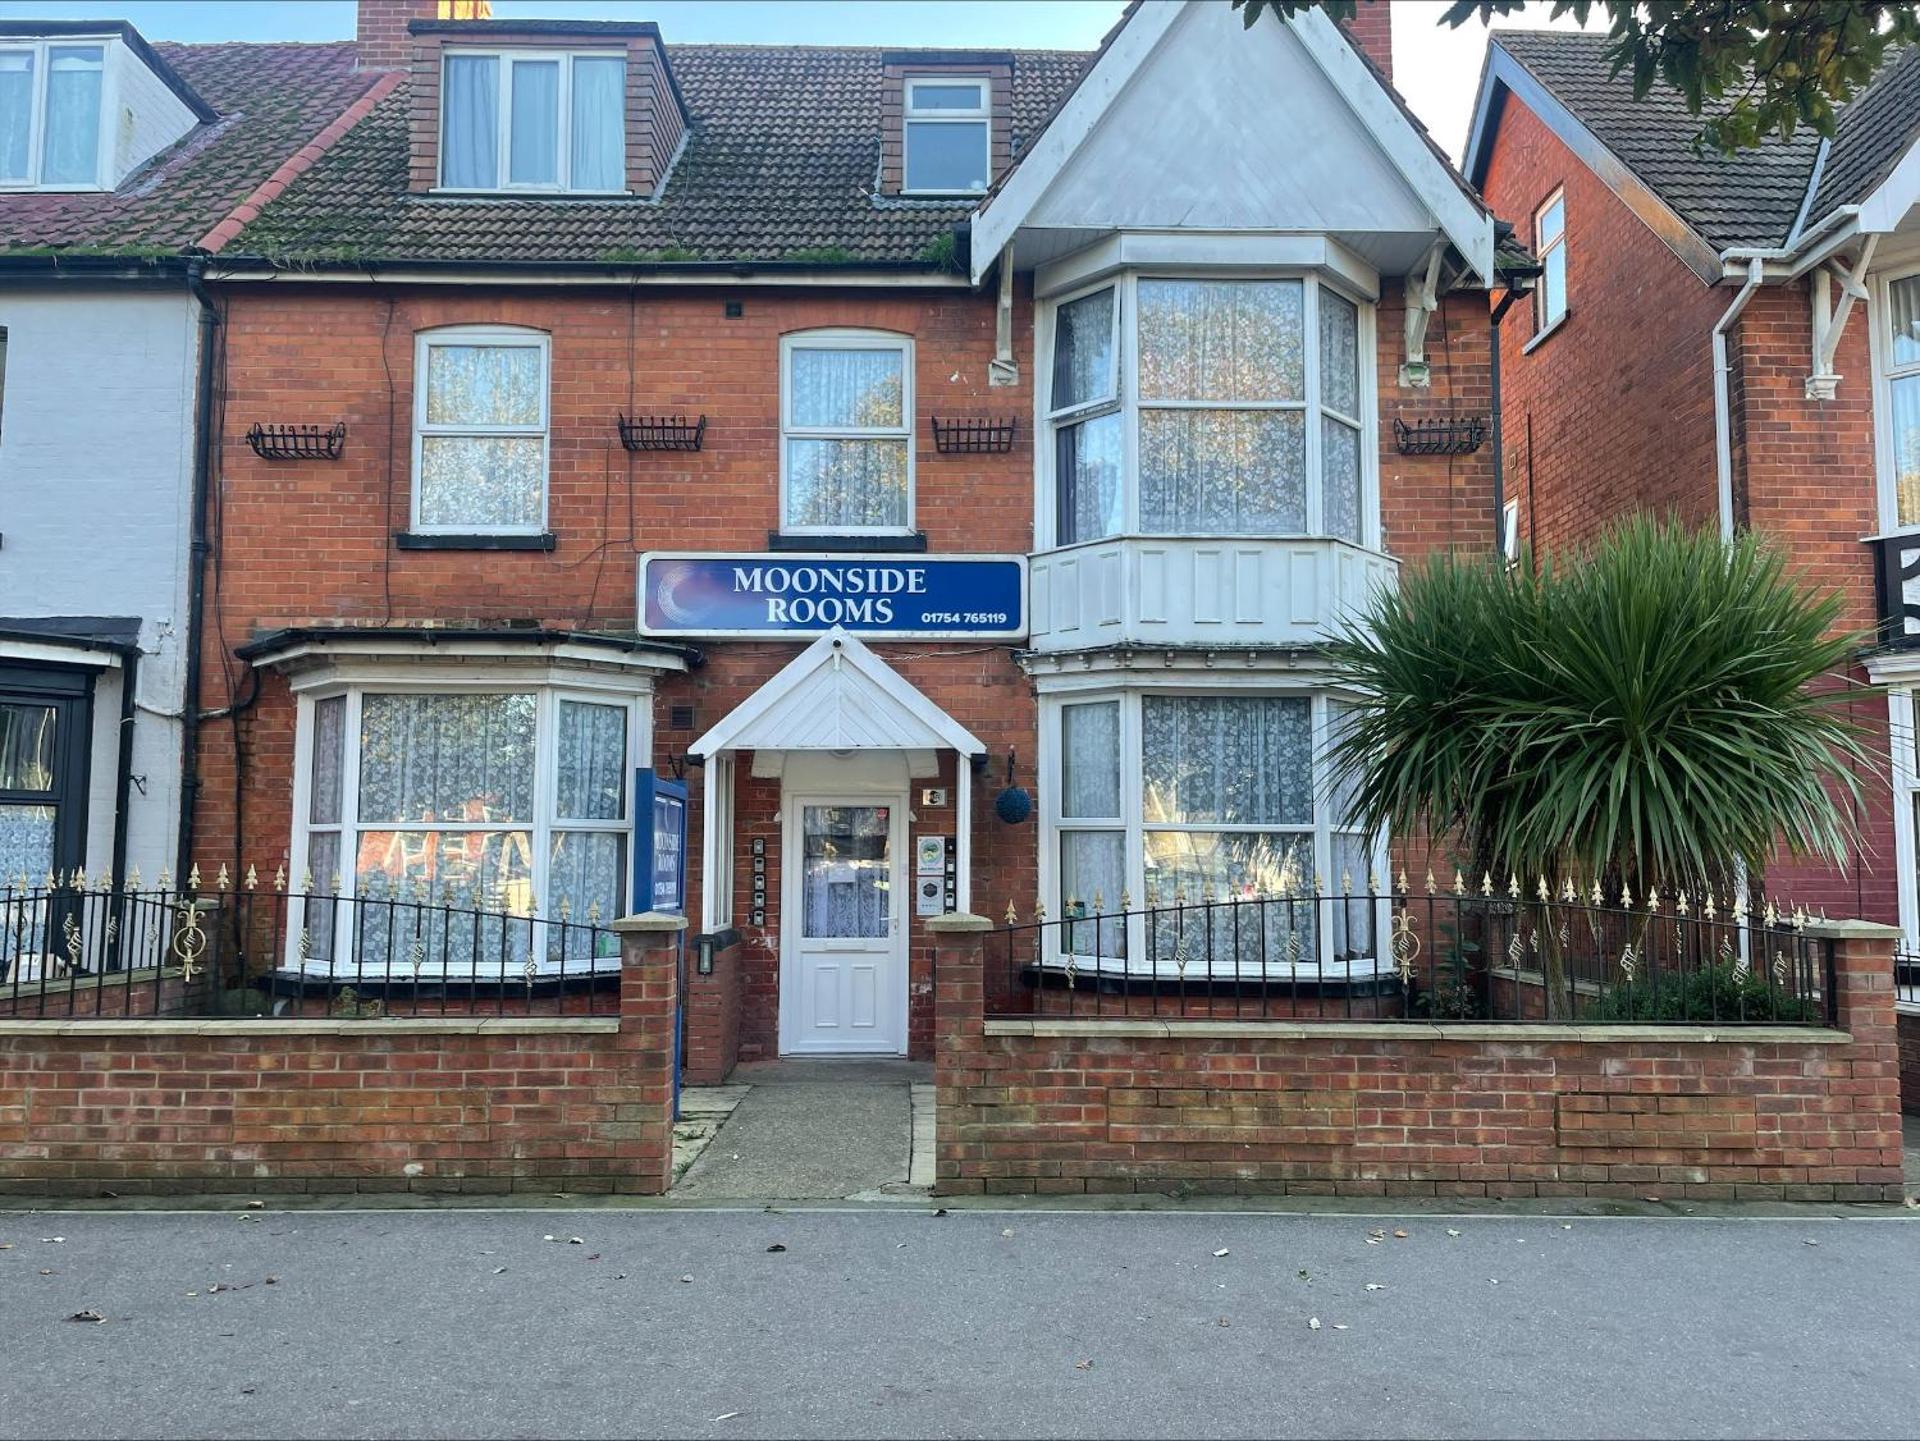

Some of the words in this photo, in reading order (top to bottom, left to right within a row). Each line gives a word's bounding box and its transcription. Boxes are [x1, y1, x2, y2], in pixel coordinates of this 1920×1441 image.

[733, 567, 926, 593] MOONSIDE
[766, 598, 893, 623] ROOMS
[921, 612, 961, 624] 01754
[963, 612, 1007, 624] 765119
